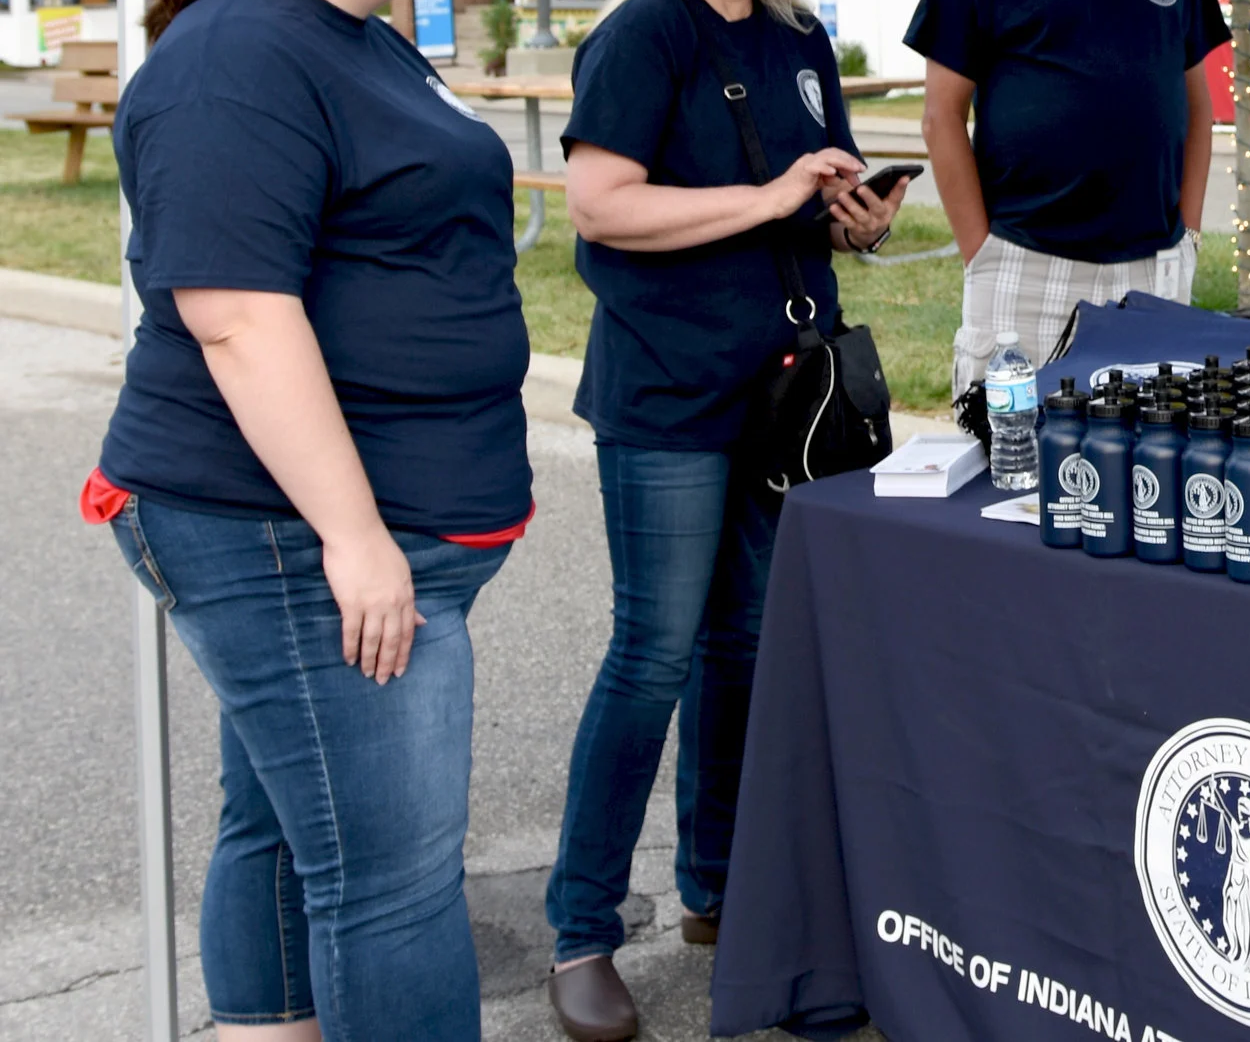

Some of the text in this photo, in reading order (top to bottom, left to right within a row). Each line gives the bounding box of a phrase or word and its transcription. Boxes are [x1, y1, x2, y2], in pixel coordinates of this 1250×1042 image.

[1159, 744, 1249, 822] ATTORNEY
[877, 909, 1133, 1042] OFFICE OF INDIANA
[1159, 885, 1208, 969] STATE
[1211, 963, 1238, 992] OF
